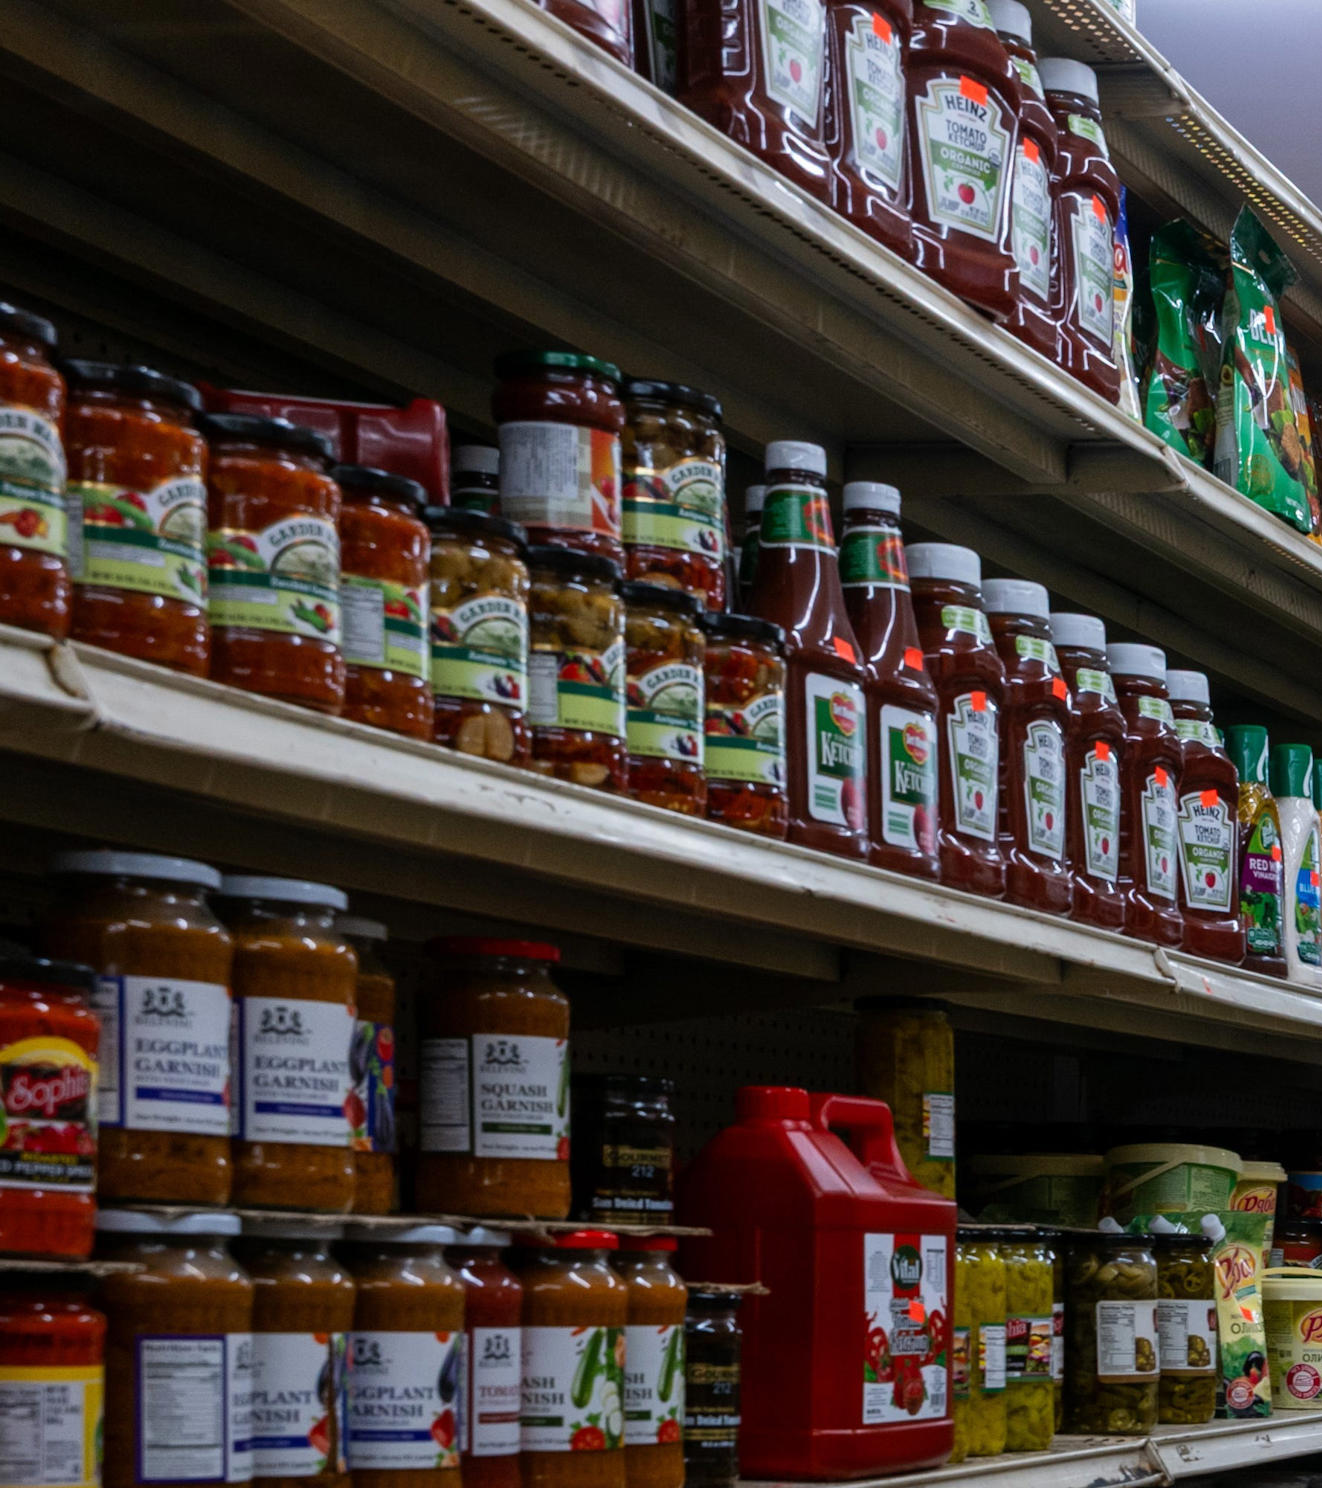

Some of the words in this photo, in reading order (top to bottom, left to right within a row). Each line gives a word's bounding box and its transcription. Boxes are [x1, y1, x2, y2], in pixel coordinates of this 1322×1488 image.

[944, 95, 988, 122] HEINZ
[945, 120, 988, 145] TOMATO
[940, 147, 991, 174] ORGANIC
[460, 600, 511, 623] GARDEN
[647, 668, 689, 689] GARDEN
[1193, 804, 1221, 820] HEINZ
[1194, 825, 1222, 837] TOMATO
[1192, 846, 1225, 860] ORGANIC
[1249, 857, 1268, 872] RED
[135, 1058, 221, 1077] GARNISH
[254, 1073, 339, 1093] GARNISH
[481, 1083, 548, 1098] SQUASH
[481, 1099, 555, 1114] GARNISH
[631, 1164, 655, 1178] 212
[893, 1253, 920, 1280] Vital
